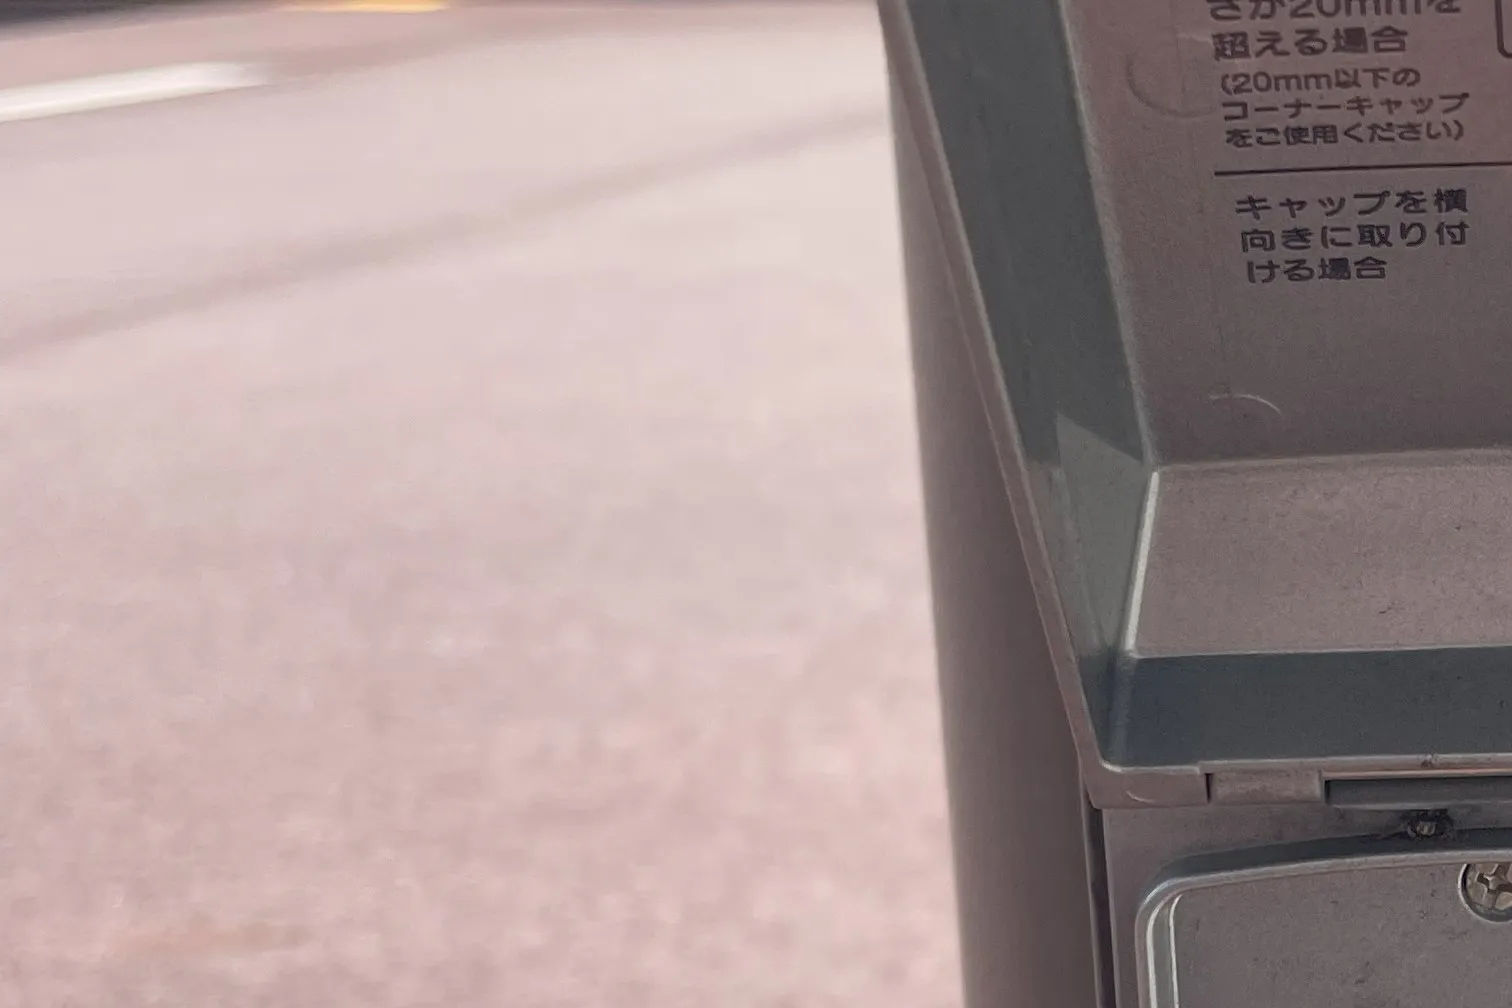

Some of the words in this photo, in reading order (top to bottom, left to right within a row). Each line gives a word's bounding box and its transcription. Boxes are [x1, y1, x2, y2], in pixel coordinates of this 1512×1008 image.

[1211, 25, 1408, 61] 超える場合
[1220, 68, 1421, 95] (20mm以下の
[1222, 92, 1470, 121] コーナーキャップ
[1225, 119, 1464, 148] をご使用ください)
[1235, 188, 1468, 220] キャップを横
[1240, 221, 1470, 252] 向きに取り付
[1246, 256, 1387, 284] ける場合
